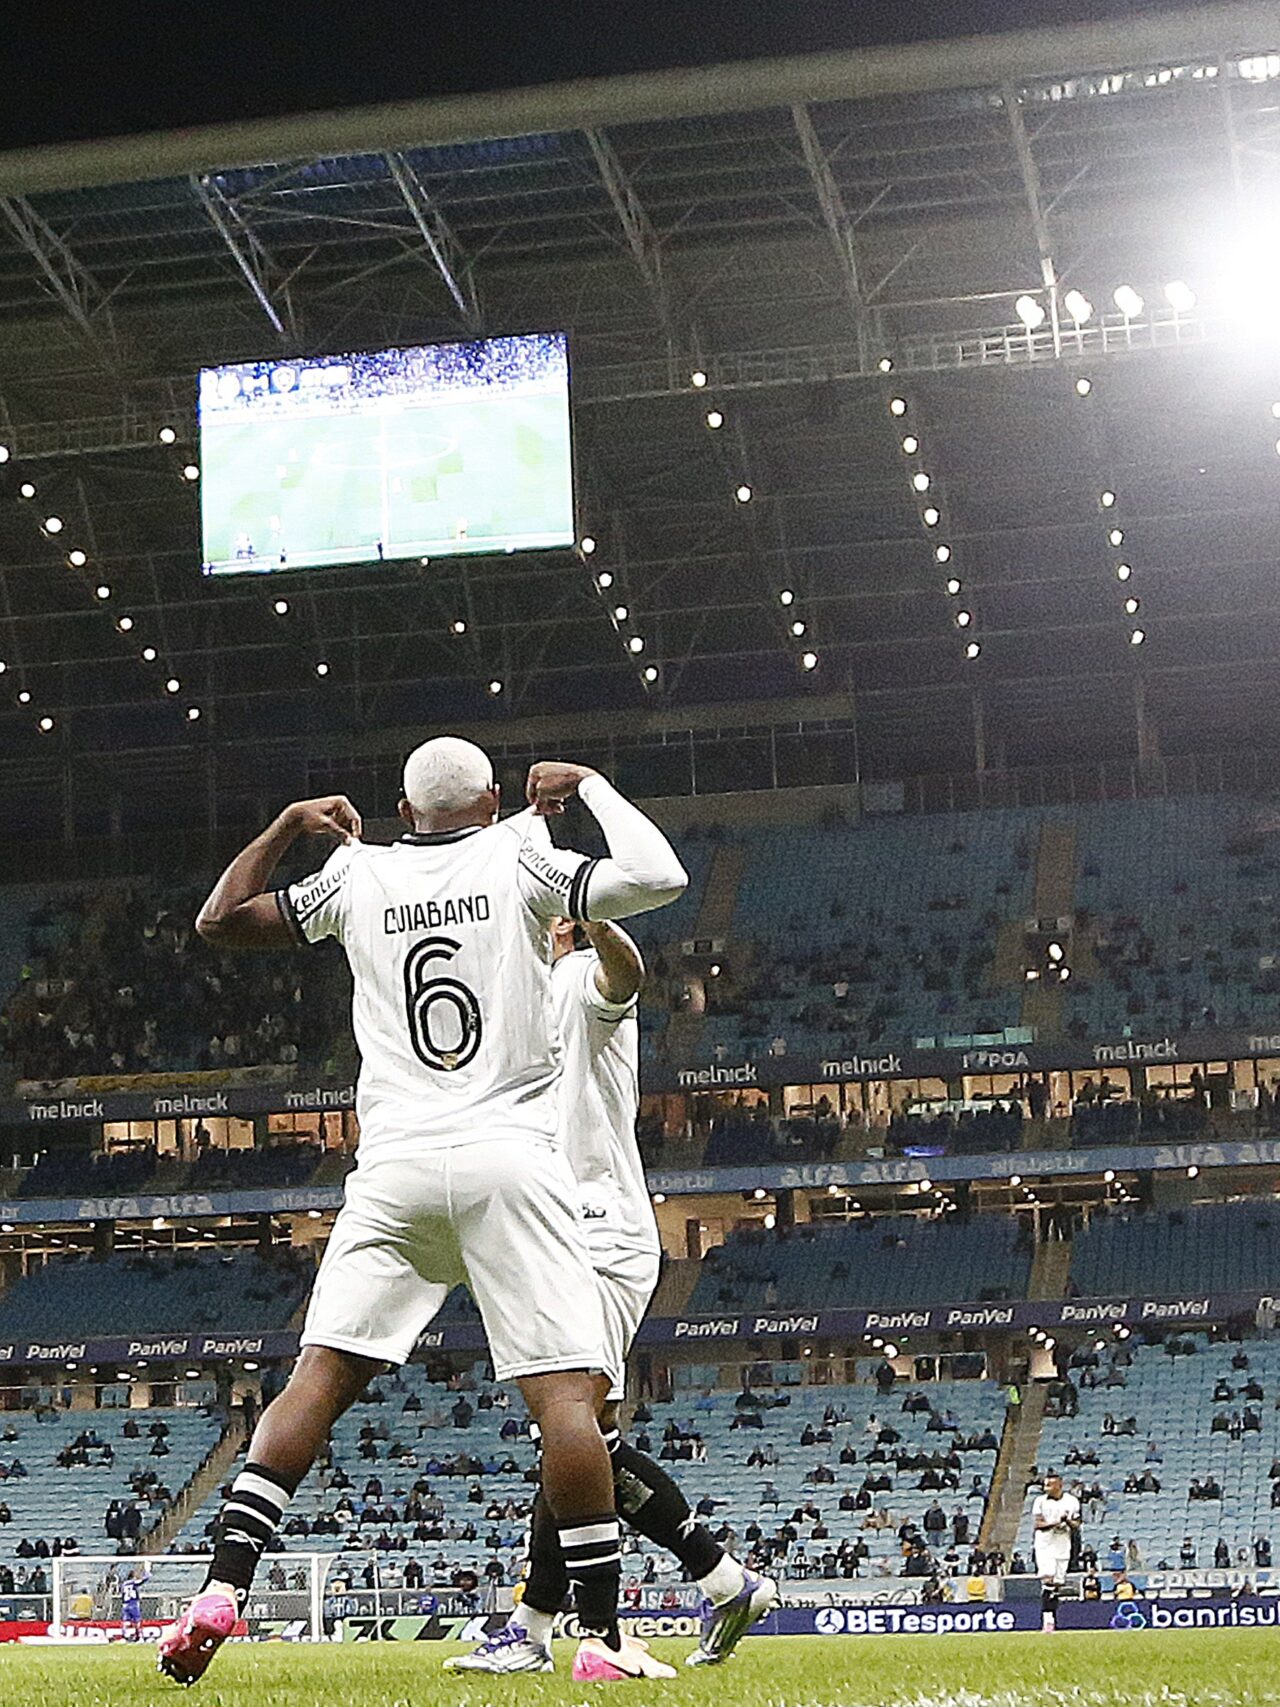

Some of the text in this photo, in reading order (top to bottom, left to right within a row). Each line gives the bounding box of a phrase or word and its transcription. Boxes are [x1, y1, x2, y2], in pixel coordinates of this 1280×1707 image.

[384, 895, 490, 934] CUIABANO
[404, 936, 482, 1071] 6
[989, 1051, 1029, 1068] POA
[847, 1609, 1015, 1634] BETesporte
